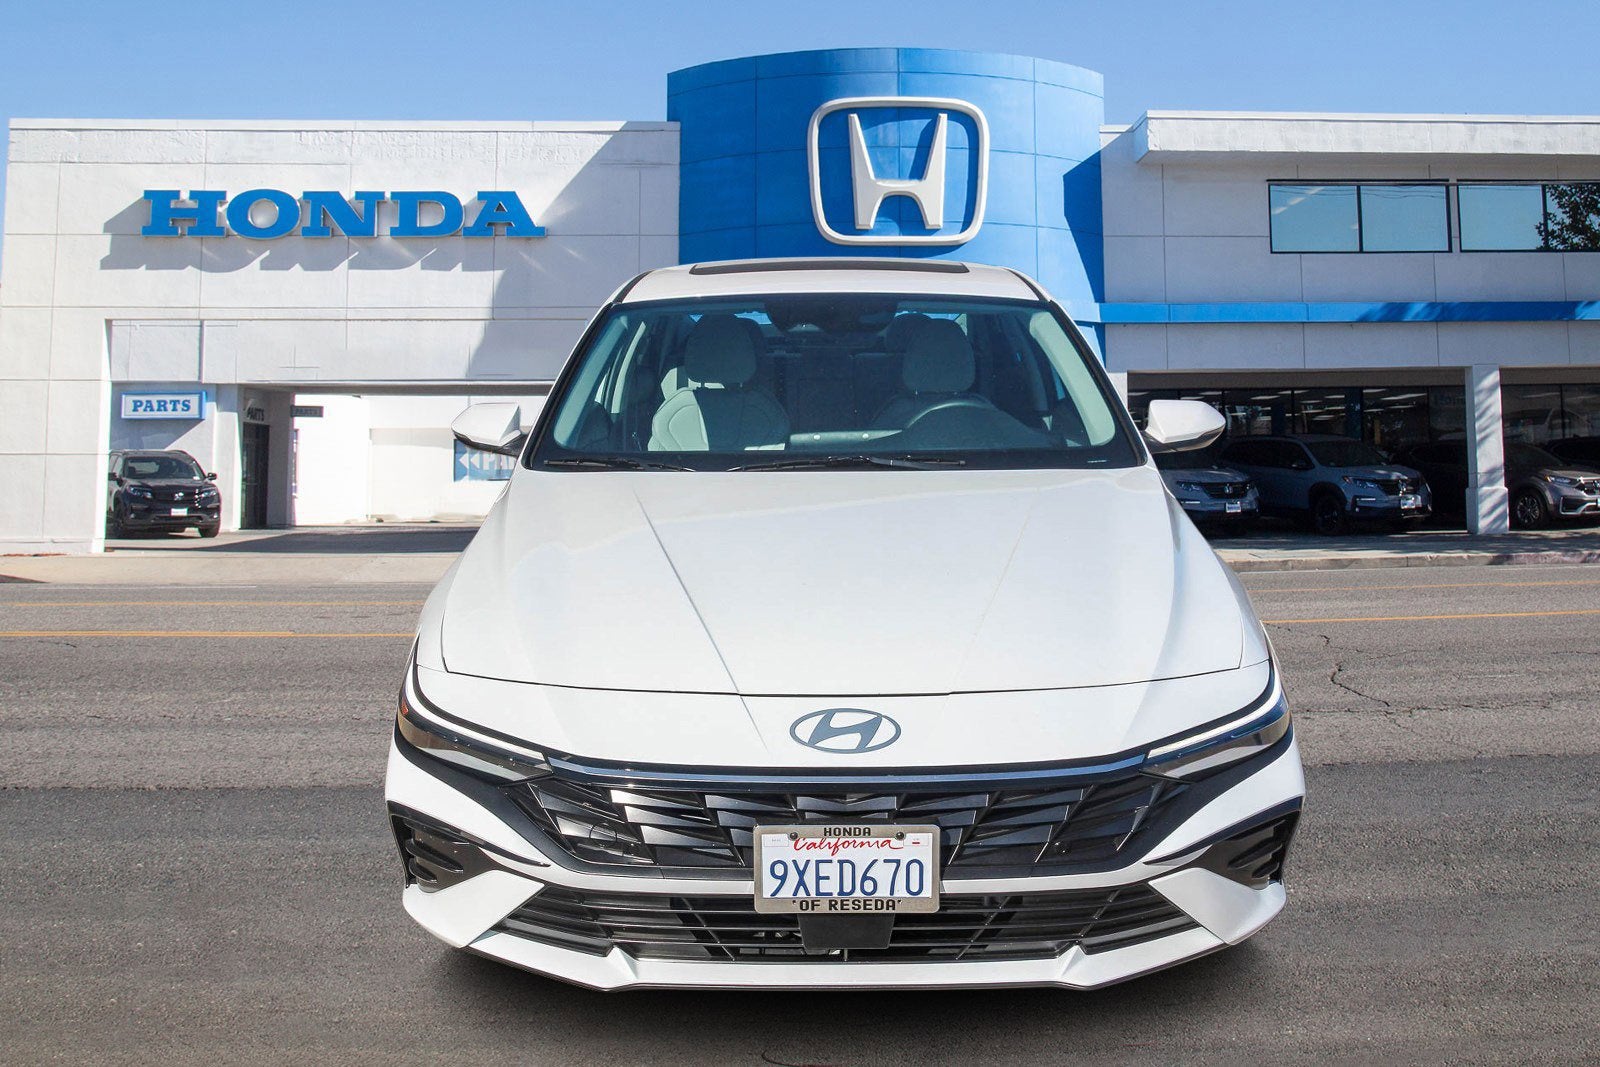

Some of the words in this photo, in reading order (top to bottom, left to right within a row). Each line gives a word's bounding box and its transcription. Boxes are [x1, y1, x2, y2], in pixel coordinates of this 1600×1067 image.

[141, 189, 547, 239] HONDA
[131, 399, 191, 412] PARTS
[823, 827, 872, 837] HONDA
[794, 837, 903, 856] California
[769, 858, 924, 897] 9XED670
[799, 899, 821, 911] OF
[828, 899, 897, 911] RESEDA
